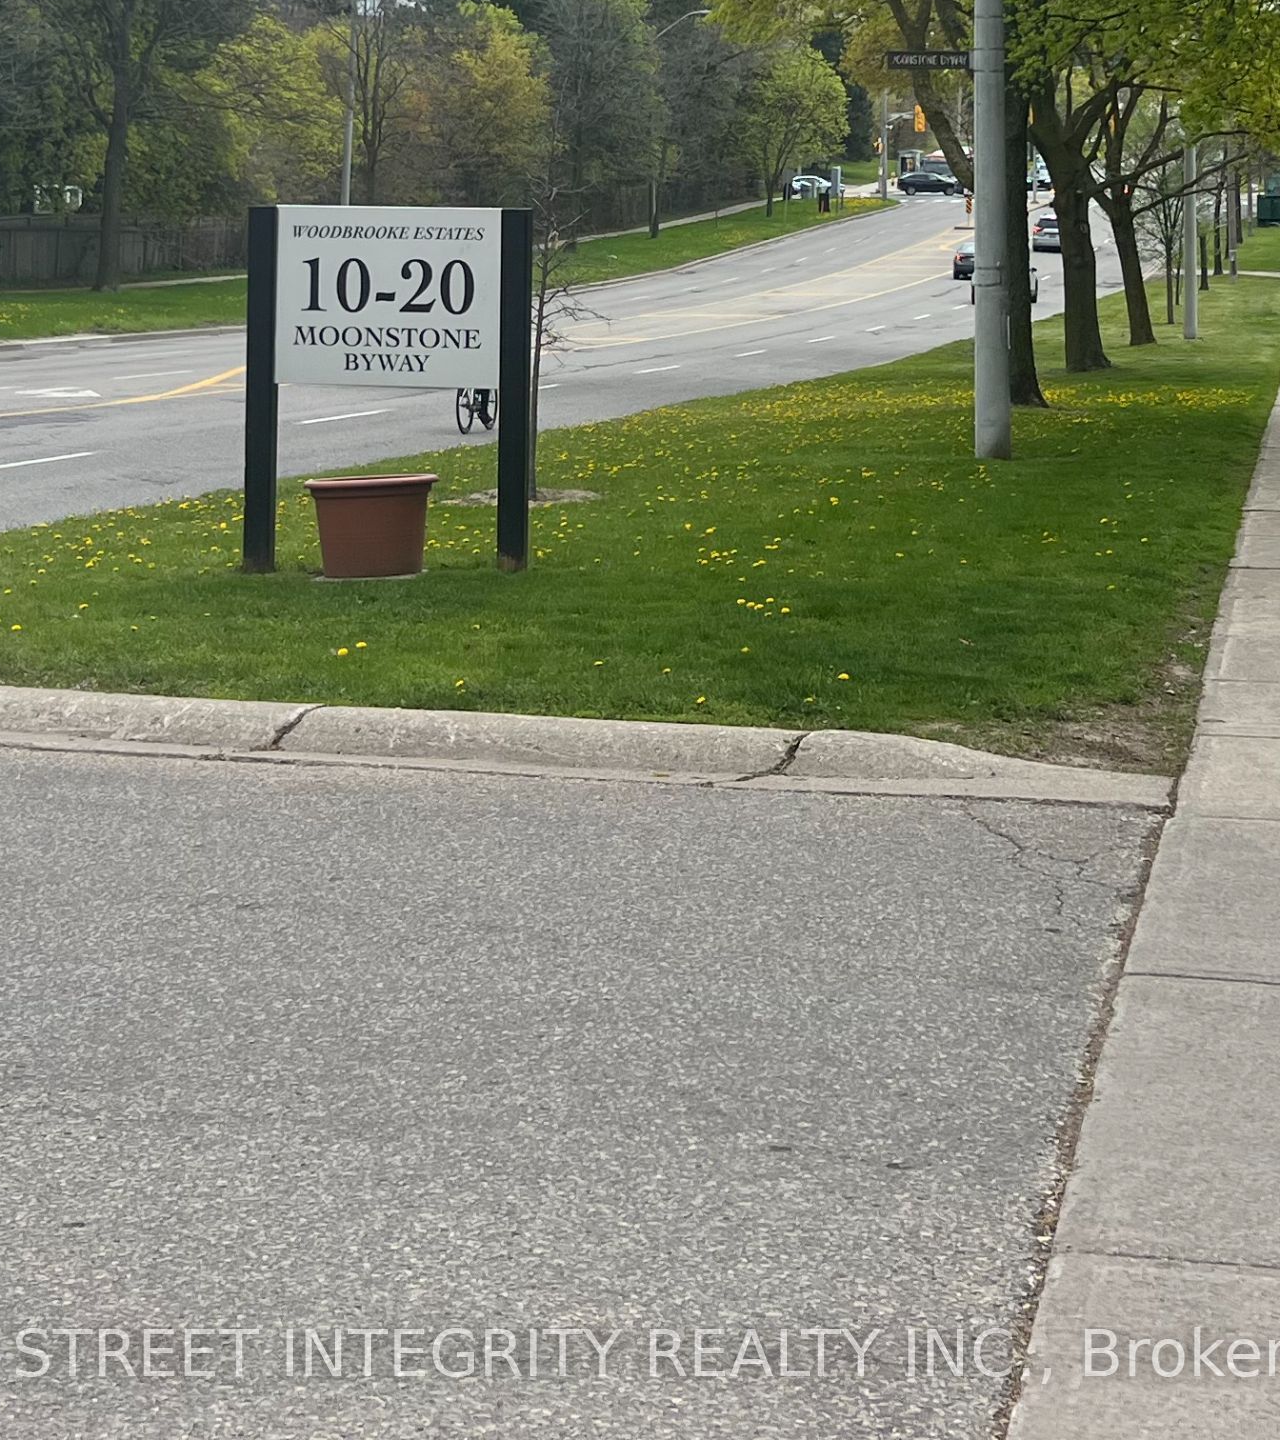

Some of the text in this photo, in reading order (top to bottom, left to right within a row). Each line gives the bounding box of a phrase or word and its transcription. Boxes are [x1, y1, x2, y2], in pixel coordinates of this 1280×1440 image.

[292, 224, 486, 241] WOODBROOKE ESTATES
[300, 257, 475, 315] 10-20
[292, 325, 482, 350] MOONSTONE
[343, 353, 431, 373] BYWAY
